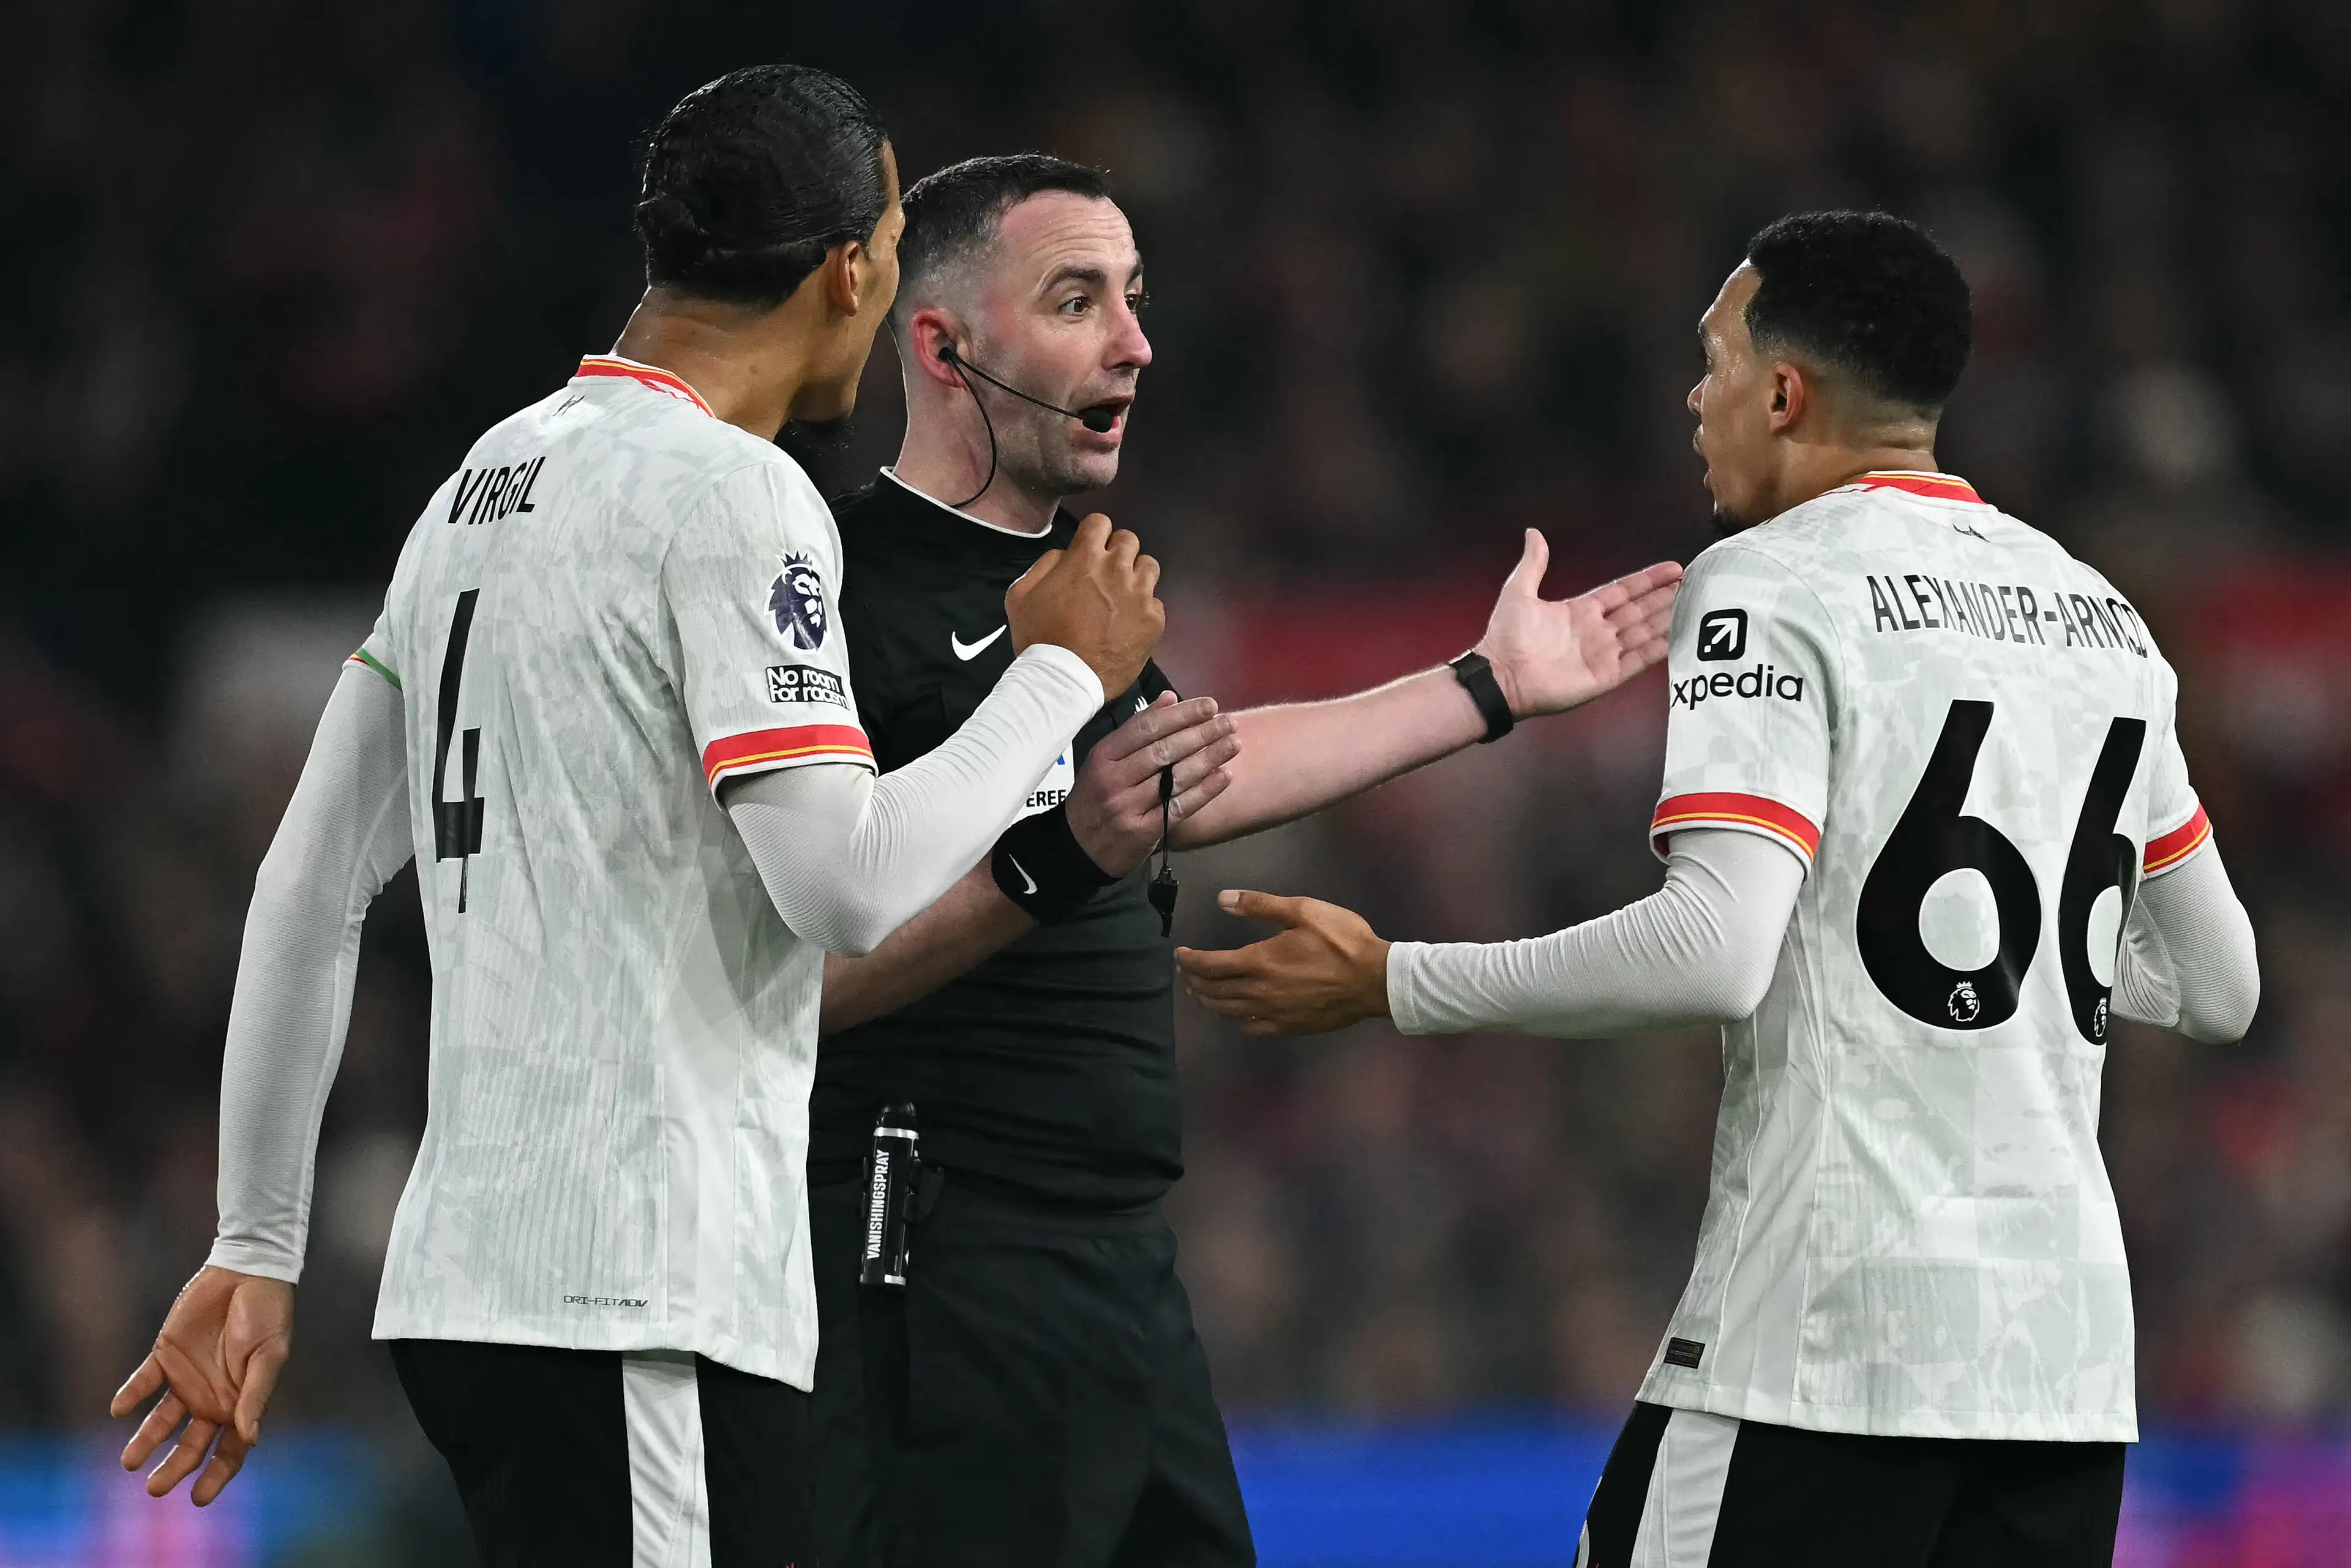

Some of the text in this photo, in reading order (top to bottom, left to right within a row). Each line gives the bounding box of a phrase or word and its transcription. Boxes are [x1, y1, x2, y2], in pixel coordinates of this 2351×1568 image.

[448, 456, 546, 525] VIRGIL
[767, 667, 840, 692] No room
[770, 685, 850, 710] for racism
[1671, 664, 1804, 710] xpedia
[432, 588, 485, 914] 4
[1026, 789, 1067, 807] EREE
[1856, 699, 2147, 1046] 66
[866, 1149, 890, 1259] VANISHINGSPRAY
